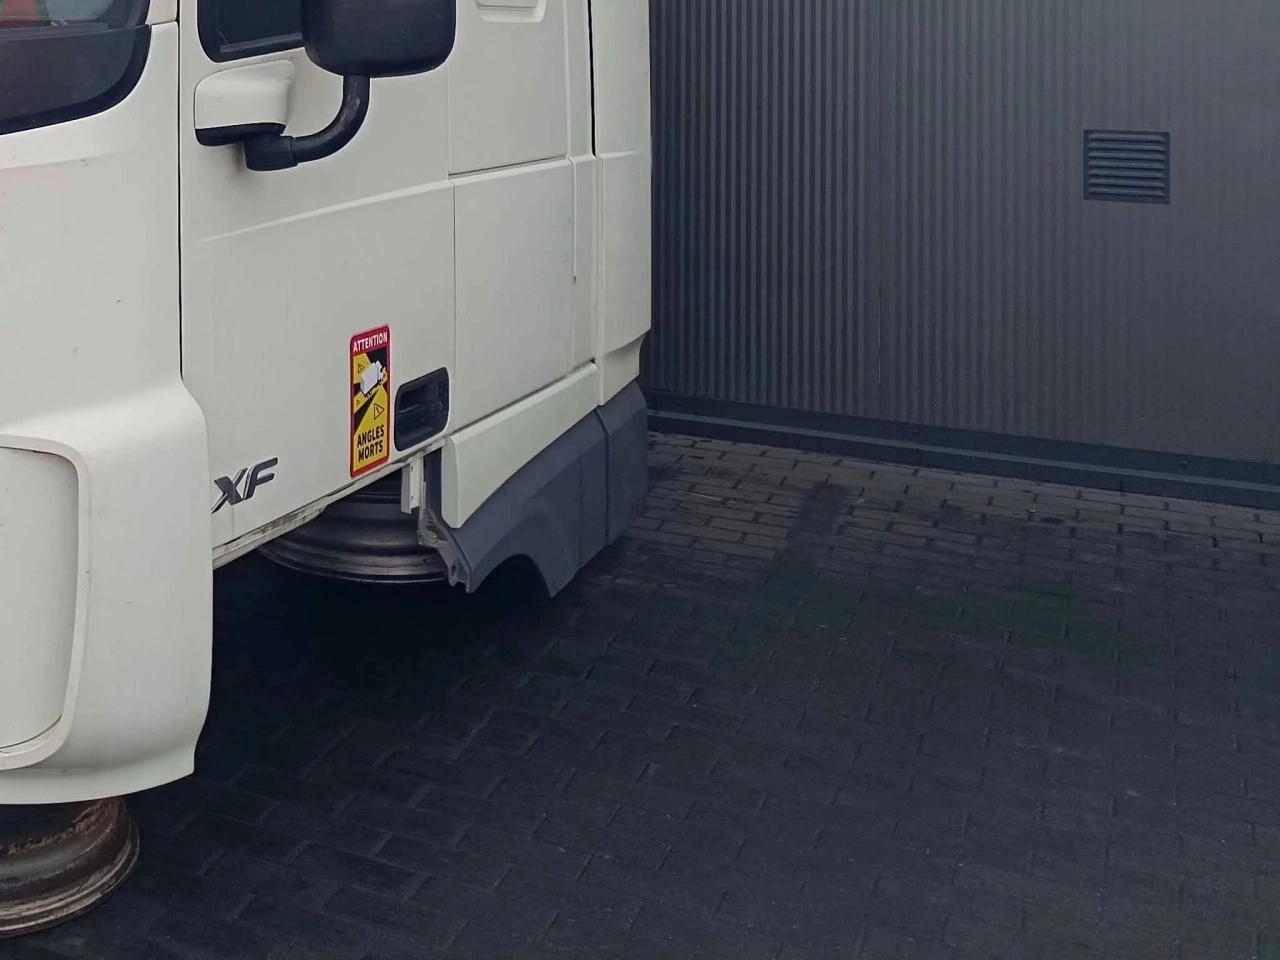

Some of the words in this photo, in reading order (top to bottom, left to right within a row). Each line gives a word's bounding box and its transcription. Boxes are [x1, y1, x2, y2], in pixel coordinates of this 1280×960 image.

[353, 331, 388, 353] ATTENTION
[357, 424, 385, 448] ANGLES
[358, 439, 383, 462] MORTS
[210, 456, 278, 514] XF
